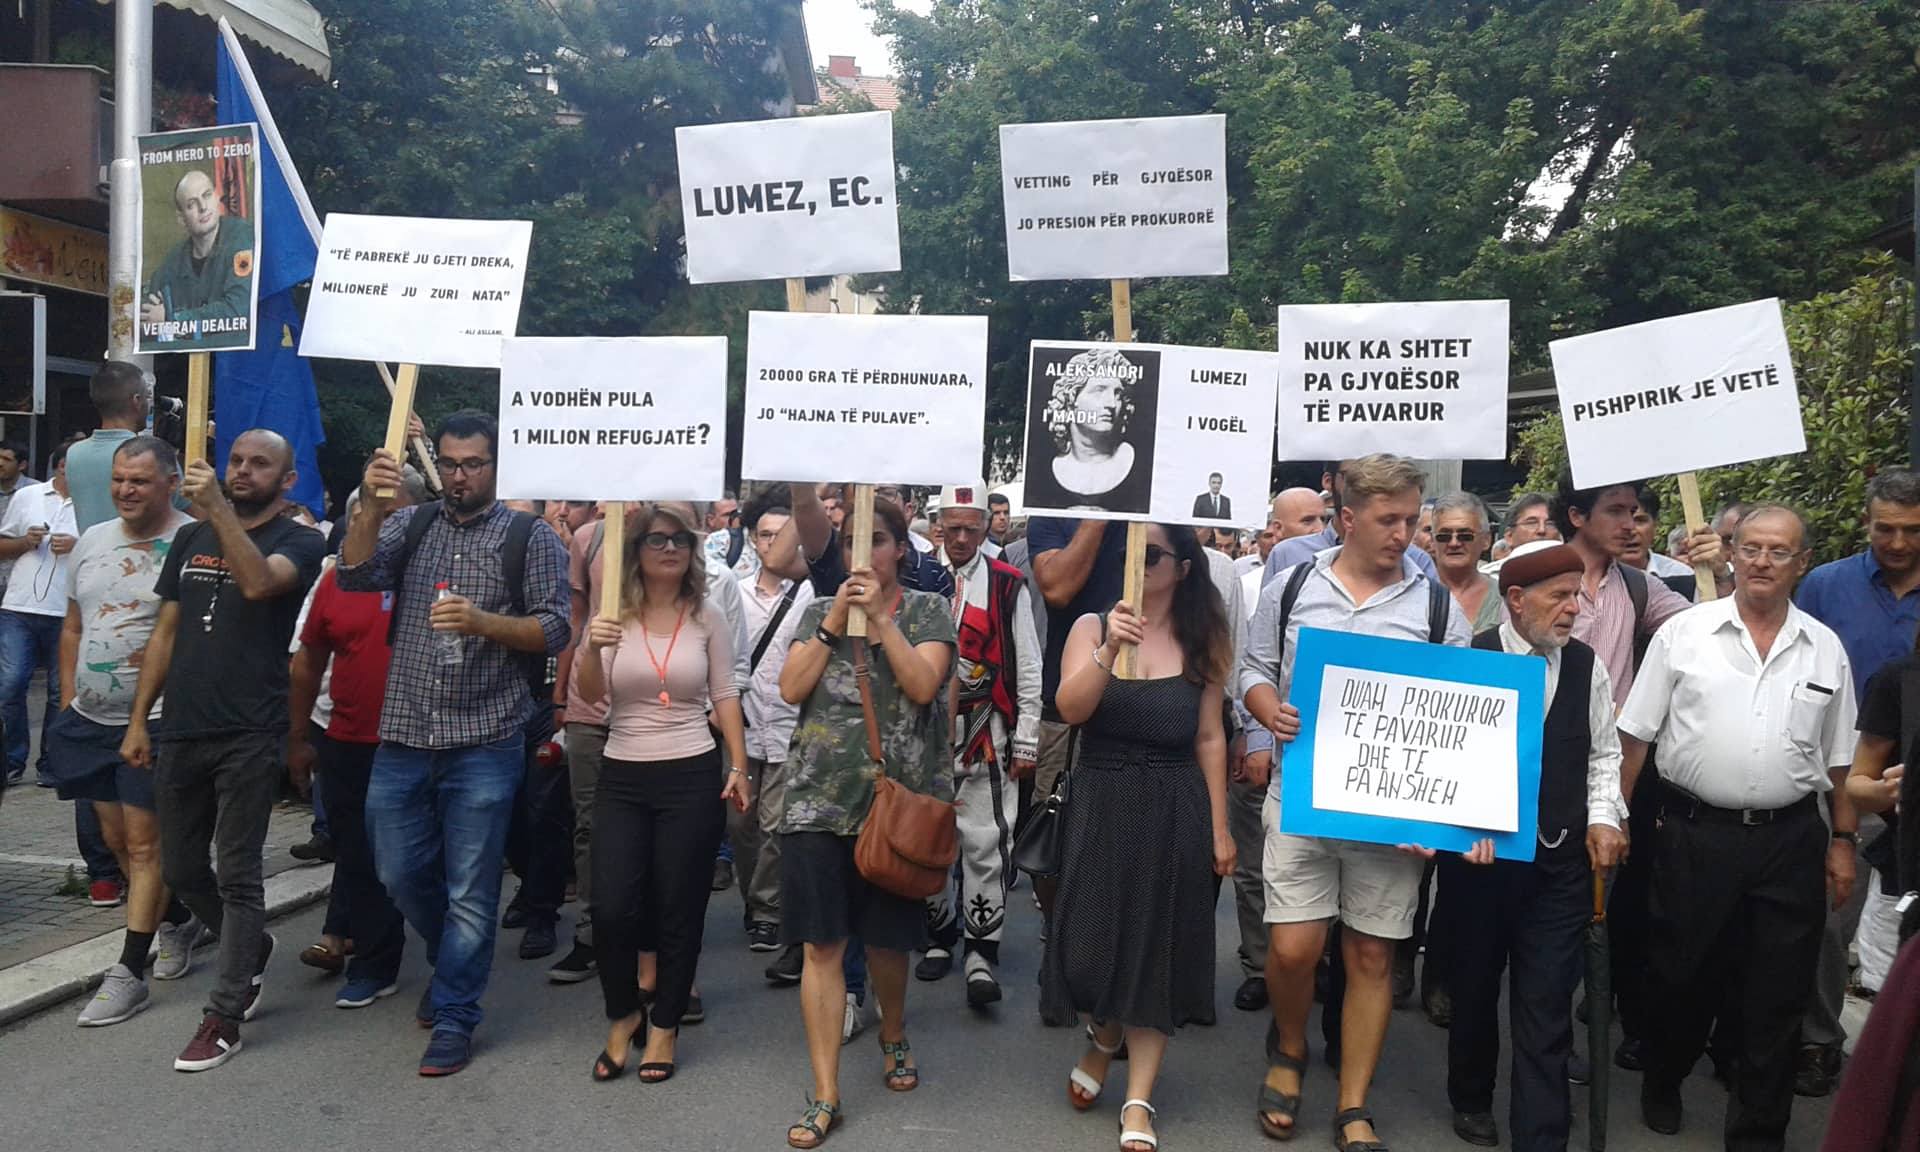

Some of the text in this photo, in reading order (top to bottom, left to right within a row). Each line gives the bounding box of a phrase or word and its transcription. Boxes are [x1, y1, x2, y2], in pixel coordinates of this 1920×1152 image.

[143, 143, 250, 164] FROM HERO TO ZERO
[1014, 167, 1213, 189] VETTING PËR GJYQËSOR
[693, 176, 883, 217] LUMEZ, EC.
[1017, 208, 1215, 230] JO PRESION PËR PROKURORË
[355, 250, 410, 263] PABREKË
[413, 253, 429, 264] JU
[433, 255, 466, 266] GJETI
[471, 256, 514, 269] DREKA,
[322, 281, 388, 296] MILIONERË
[401, 287, 417, 297] JU
[430, 288, 458, 300] ZURI
[143, 317, 247, 336] VETERAN DEALER
[1304, 338, 1472, 360] NUK KA SHTET
[760, 368, 973, 389] 20000 GRA TË PËRDHUNUARA,
[1045, 362, 1143, 380] ALEKSANDRI
[1190, 369, 1247, 386] LUMEZI
[1304, 366, 1460, 391] PA GJYQËSOR
[511, 388, 654, 407] A VODHËN PULA
[1573, 364, 1779, 422] PISHPIRIK JE VETË
[757, 408, 774, 420] JO
[840, 408, 857, 423] TË
[1042, 408, 1098, 424] I MADH
[1303, 399, 1445, 422] TË PAVARUR
[512, 423, 710, 445] 1 MILION REFUGJATË?
[1187, 415, 1248, 433] I VOGËL
[1400, 686, 1506, 728] PROKUROR
[1344, 711, 1467, 751] TE PAVARUR
[1358, 743, 1429, 774] DHE TE
